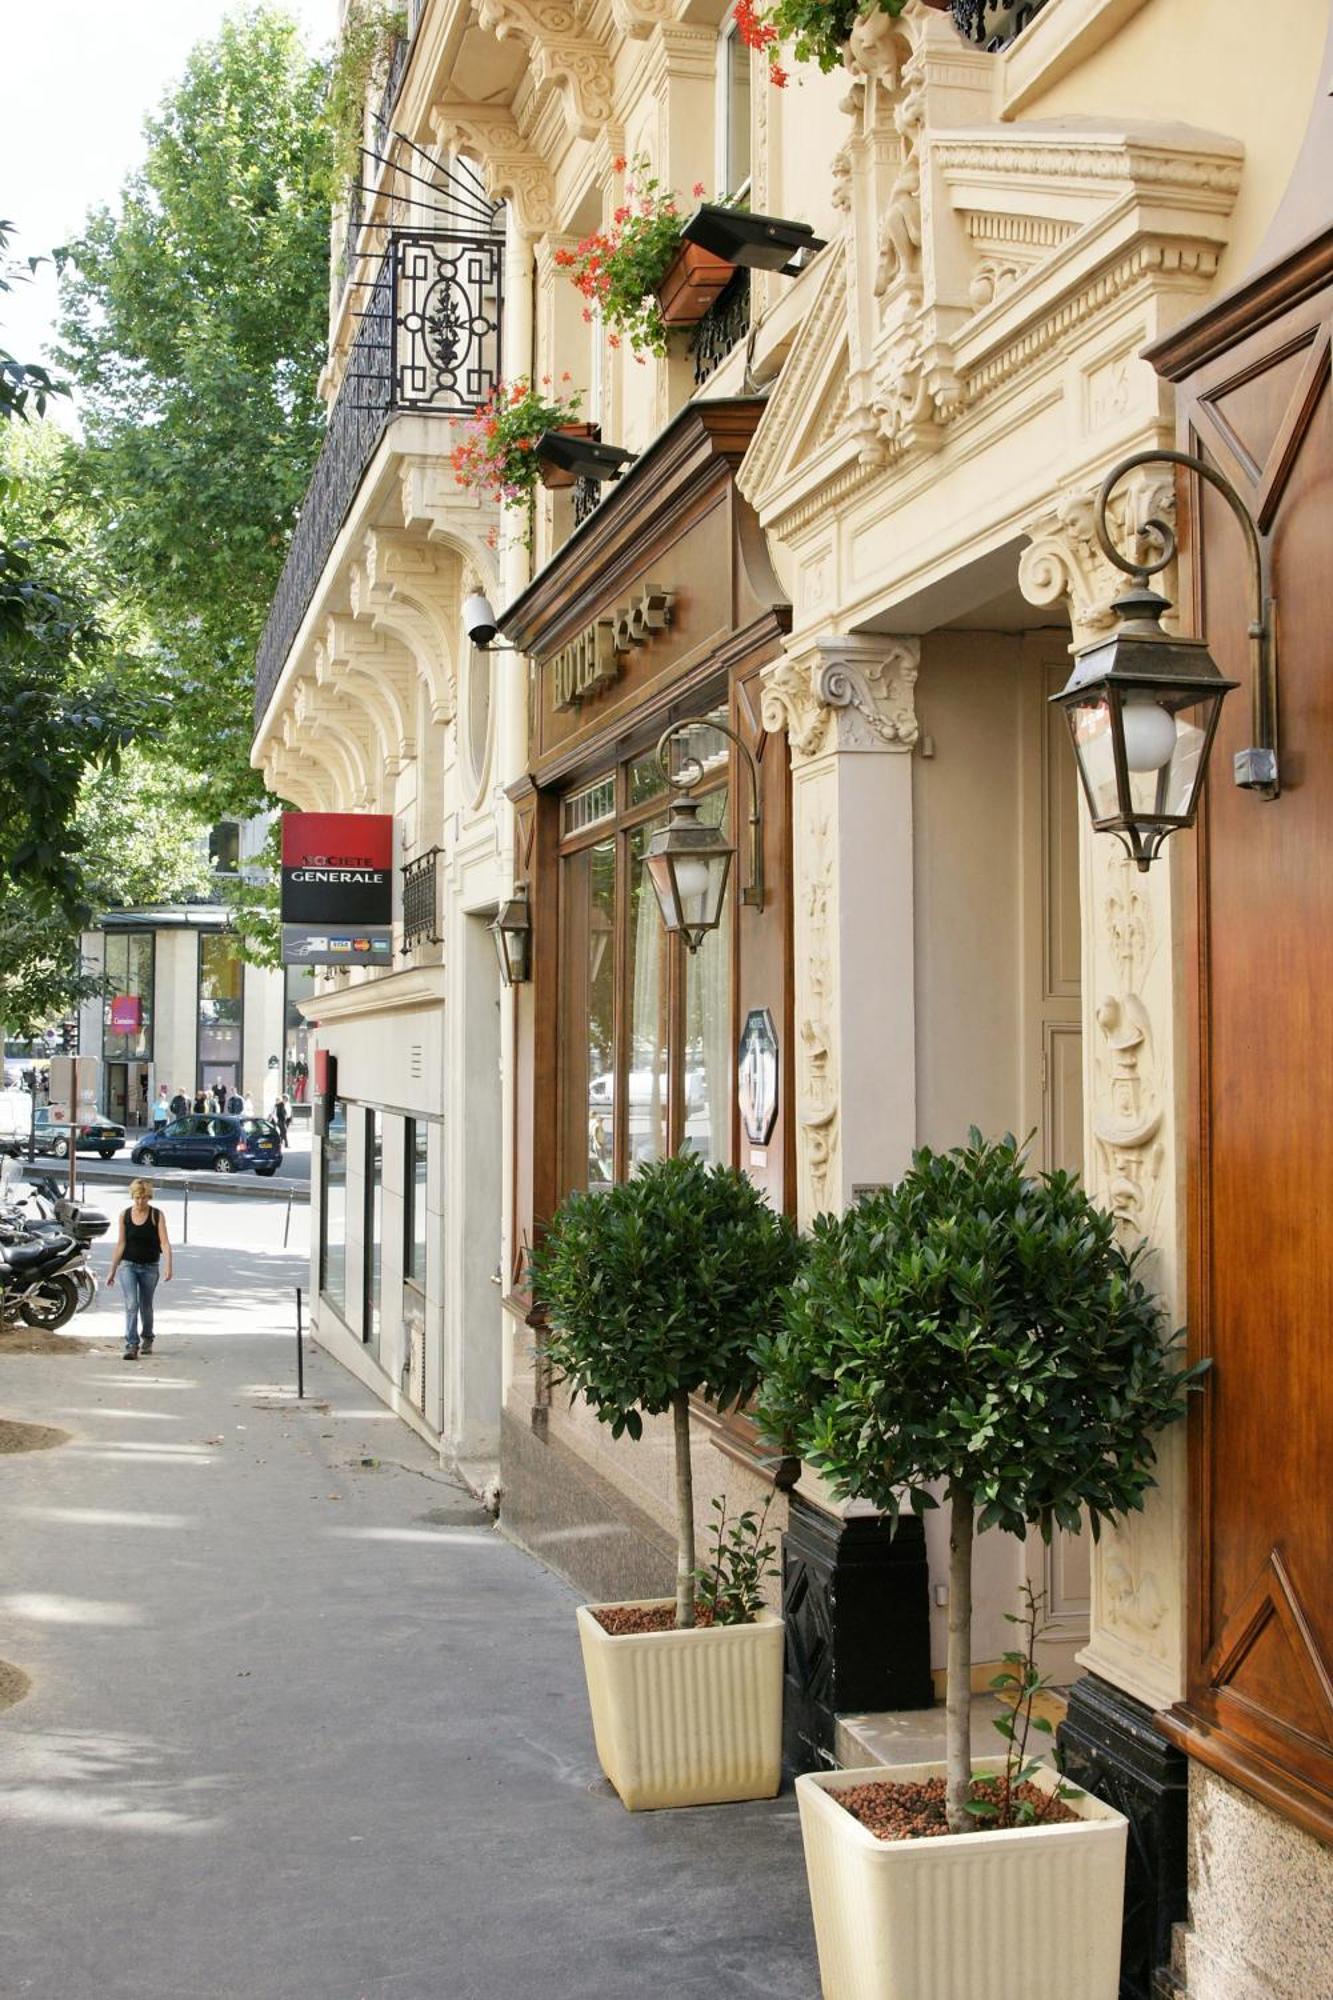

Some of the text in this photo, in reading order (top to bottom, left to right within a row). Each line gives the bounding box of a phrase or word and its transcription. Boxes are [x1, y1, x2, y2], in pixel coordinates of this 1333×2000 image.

[552, 617, 618, 713] HOTEL
[302, 856, 373, 866] SOCIETE
[291, 871, 383, 883] GENERALE
